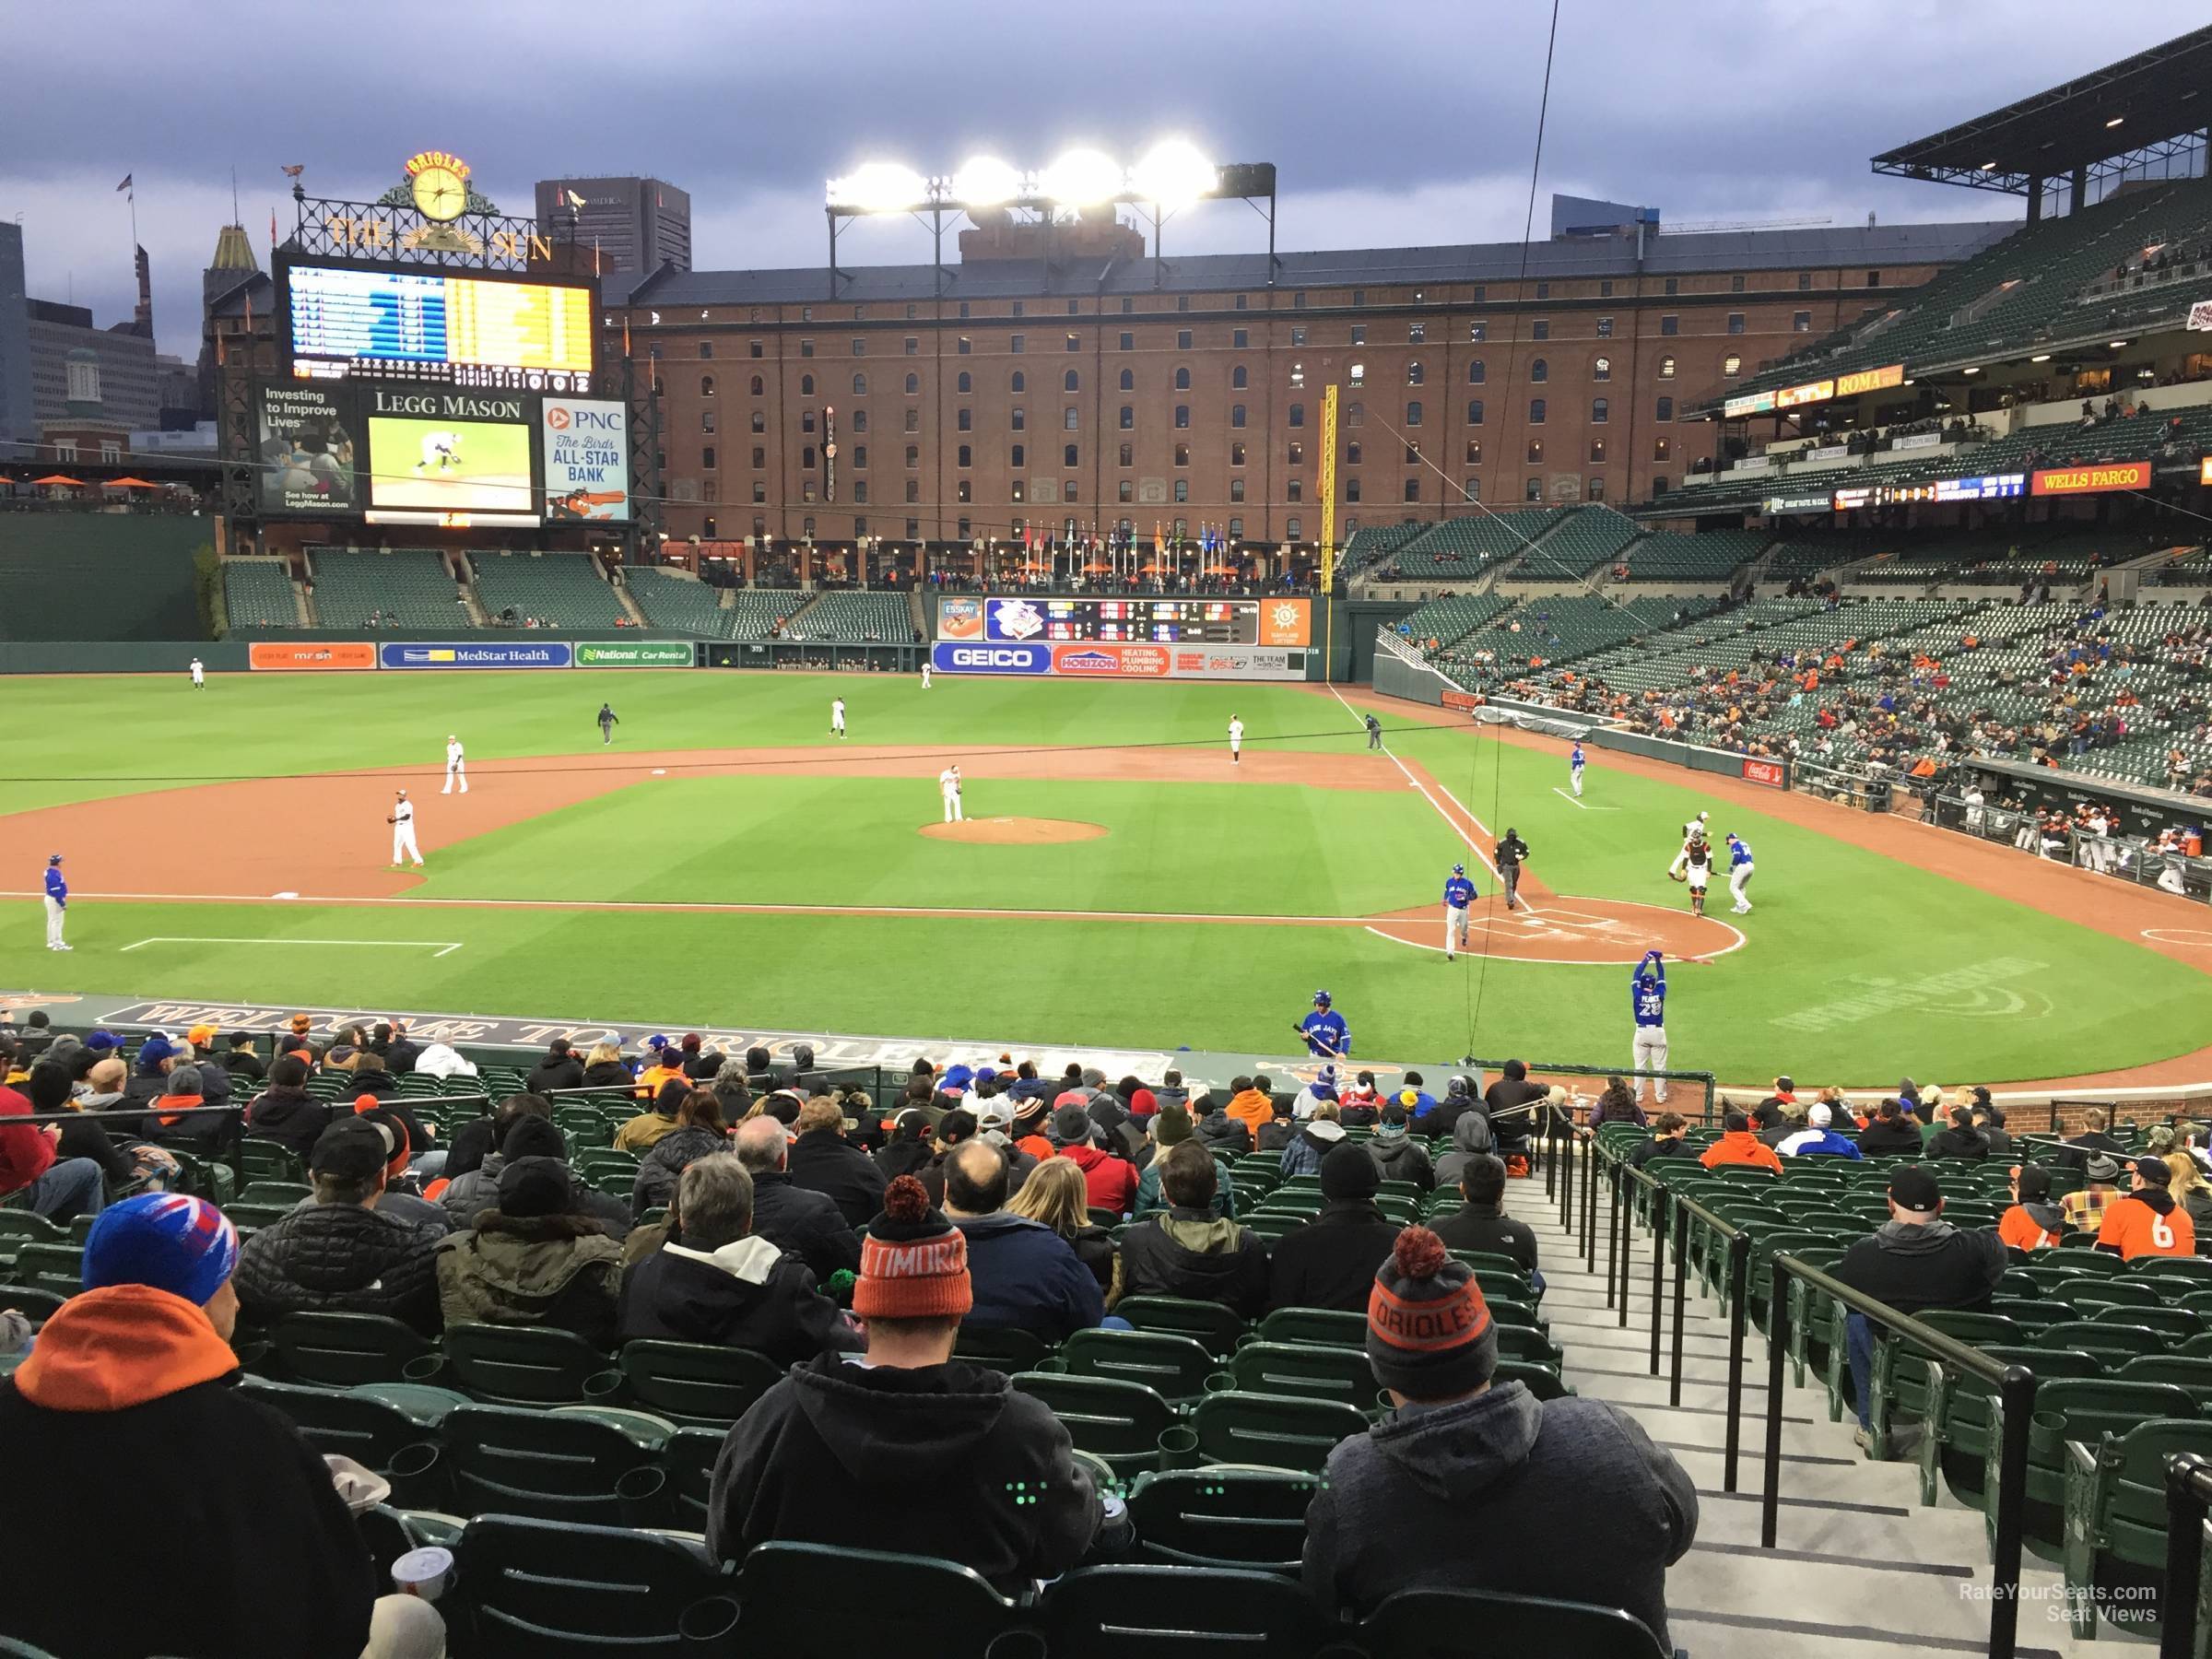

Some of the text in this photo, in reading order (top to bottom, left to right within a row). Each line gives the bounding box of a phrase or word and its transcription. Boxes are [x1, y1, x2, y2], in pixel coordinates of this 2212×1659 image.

[406, 150, 470, 179] ORIOLES
[324, 216, 394, 247] THE
[492, 229, 552, 261] SUN
[576, 378, 589, 393] 2
[1839, 371, 1881, 394] ROMA
[265, 387, 324, 404] Investing
[265, 402, 337, 417] to Improve
[374, 391, 521, 418] LEGG MASON
[573, 411, 622, 430] PNC
[556, 434, 615, 450] The Birds
[553, 449, 619, 466] ALL-STAR
[568, 466, 605, 482] BANK
[2042, 473, 2088, 489] WELLS
[2091, 468, 2139, 487] FARGO
[285, 490, 300, 499] See
[301, 491, 320, 500] how
[285, 499, 348, 509] LeggMason.com
[457, 650, 550, 661] MedStar Health
[595, 649, 638, 659] National
[658, 651, 687, 659] Rental
[953, 648, 1033, 667] GEICO
[1121, 657, 1165, 665] PLUMBING
[1266, 655, 1286, 664] TEAM
[1061, 658, 1117, 668] HORIZON
[1121, 665, 1159, 673] COOLING
[1639, 1002, 1662, 1017] 28
[511, 1024, 619, 1046] TO
[2151, 1213, 2175, 1249] 6
[1376, 1295, 1476, 1337] ORIOLES
